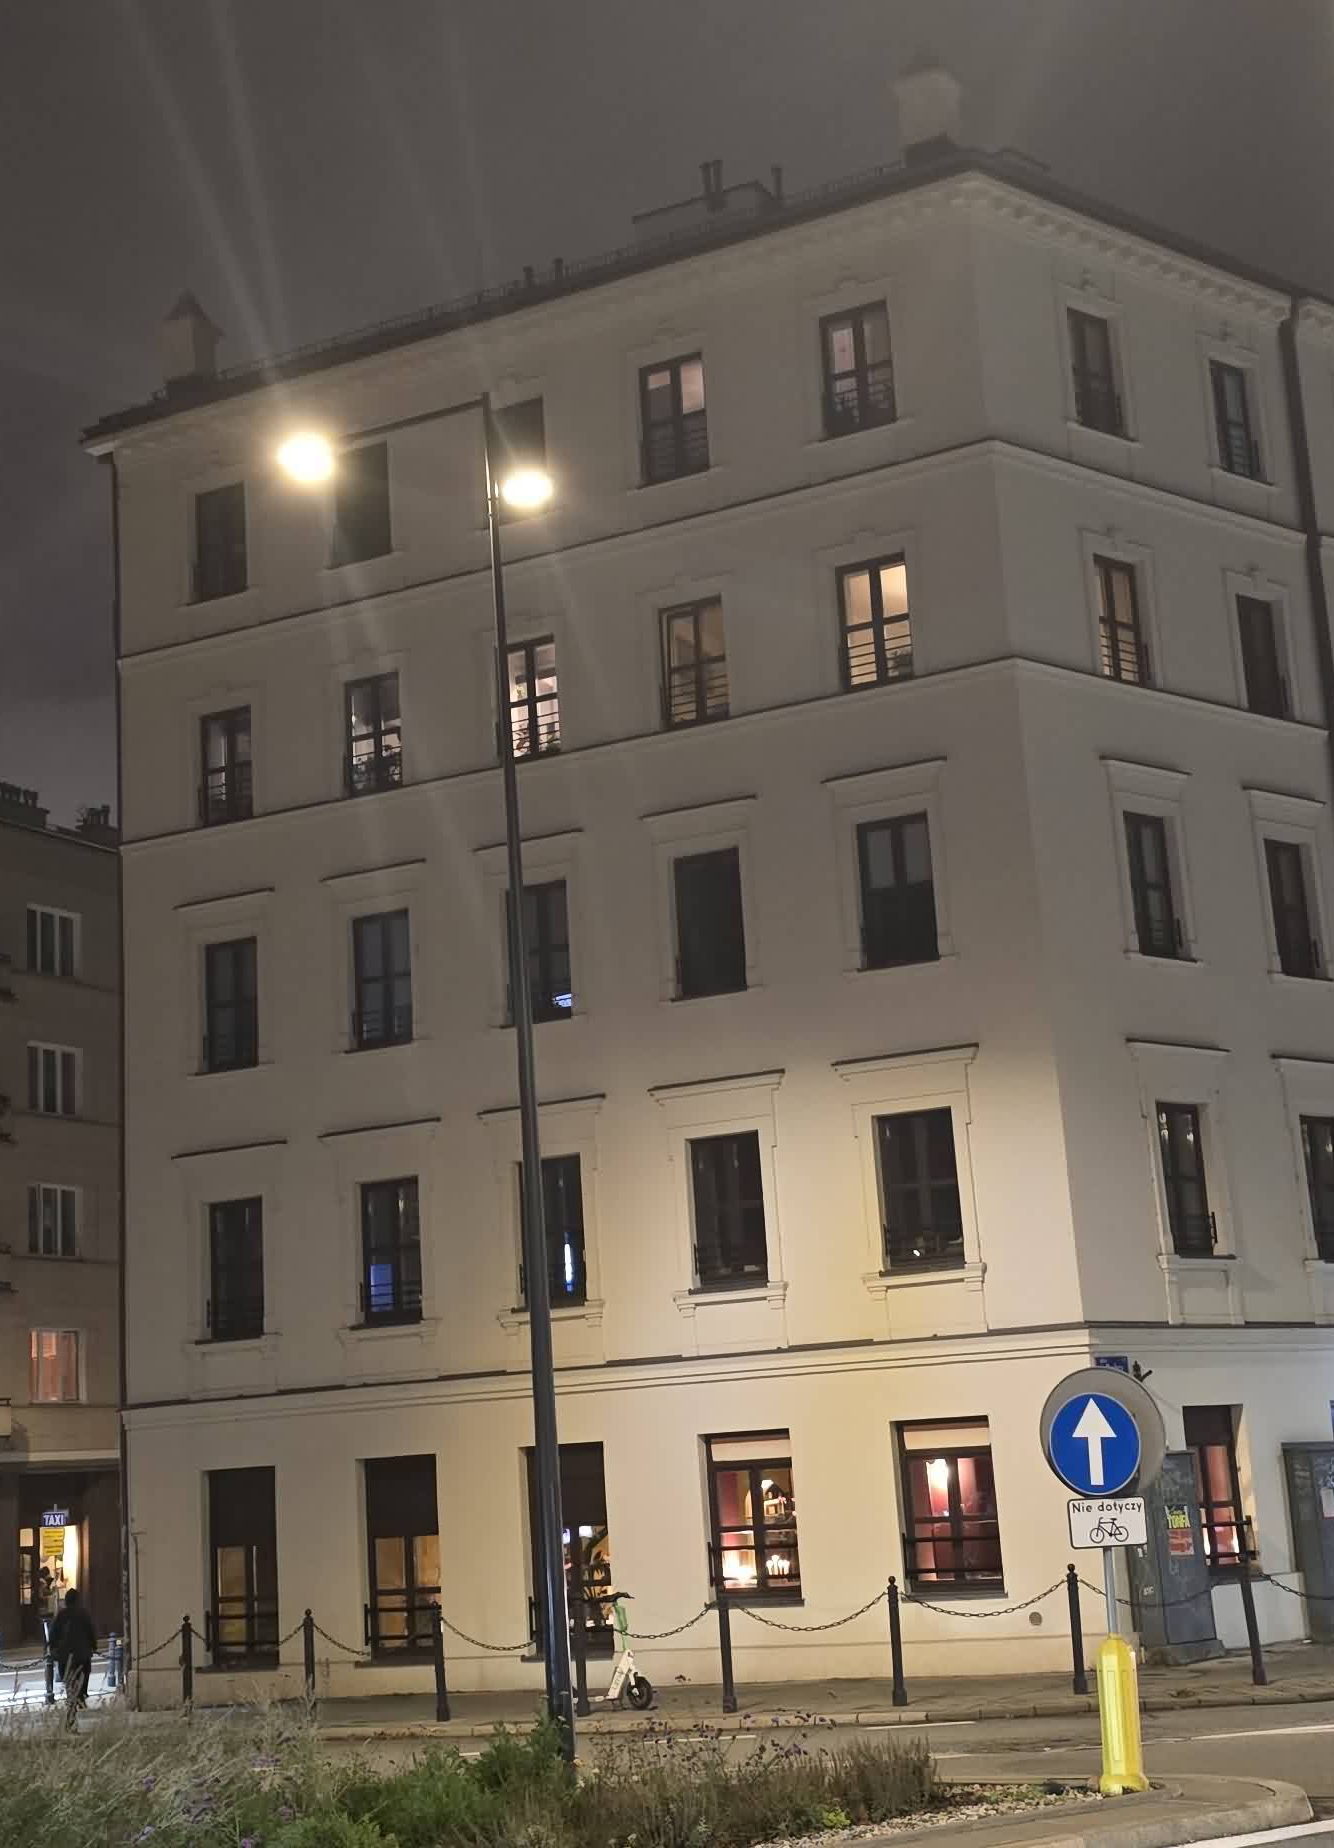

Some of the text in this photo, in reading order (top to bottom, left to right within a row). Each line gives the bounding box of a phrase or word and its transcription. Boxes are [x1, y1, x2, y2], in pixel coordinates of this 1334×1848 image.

[1072, 1501, 1142, 1514] Nie dotyczy
[42, 1514, 64, 1526] TAXI
